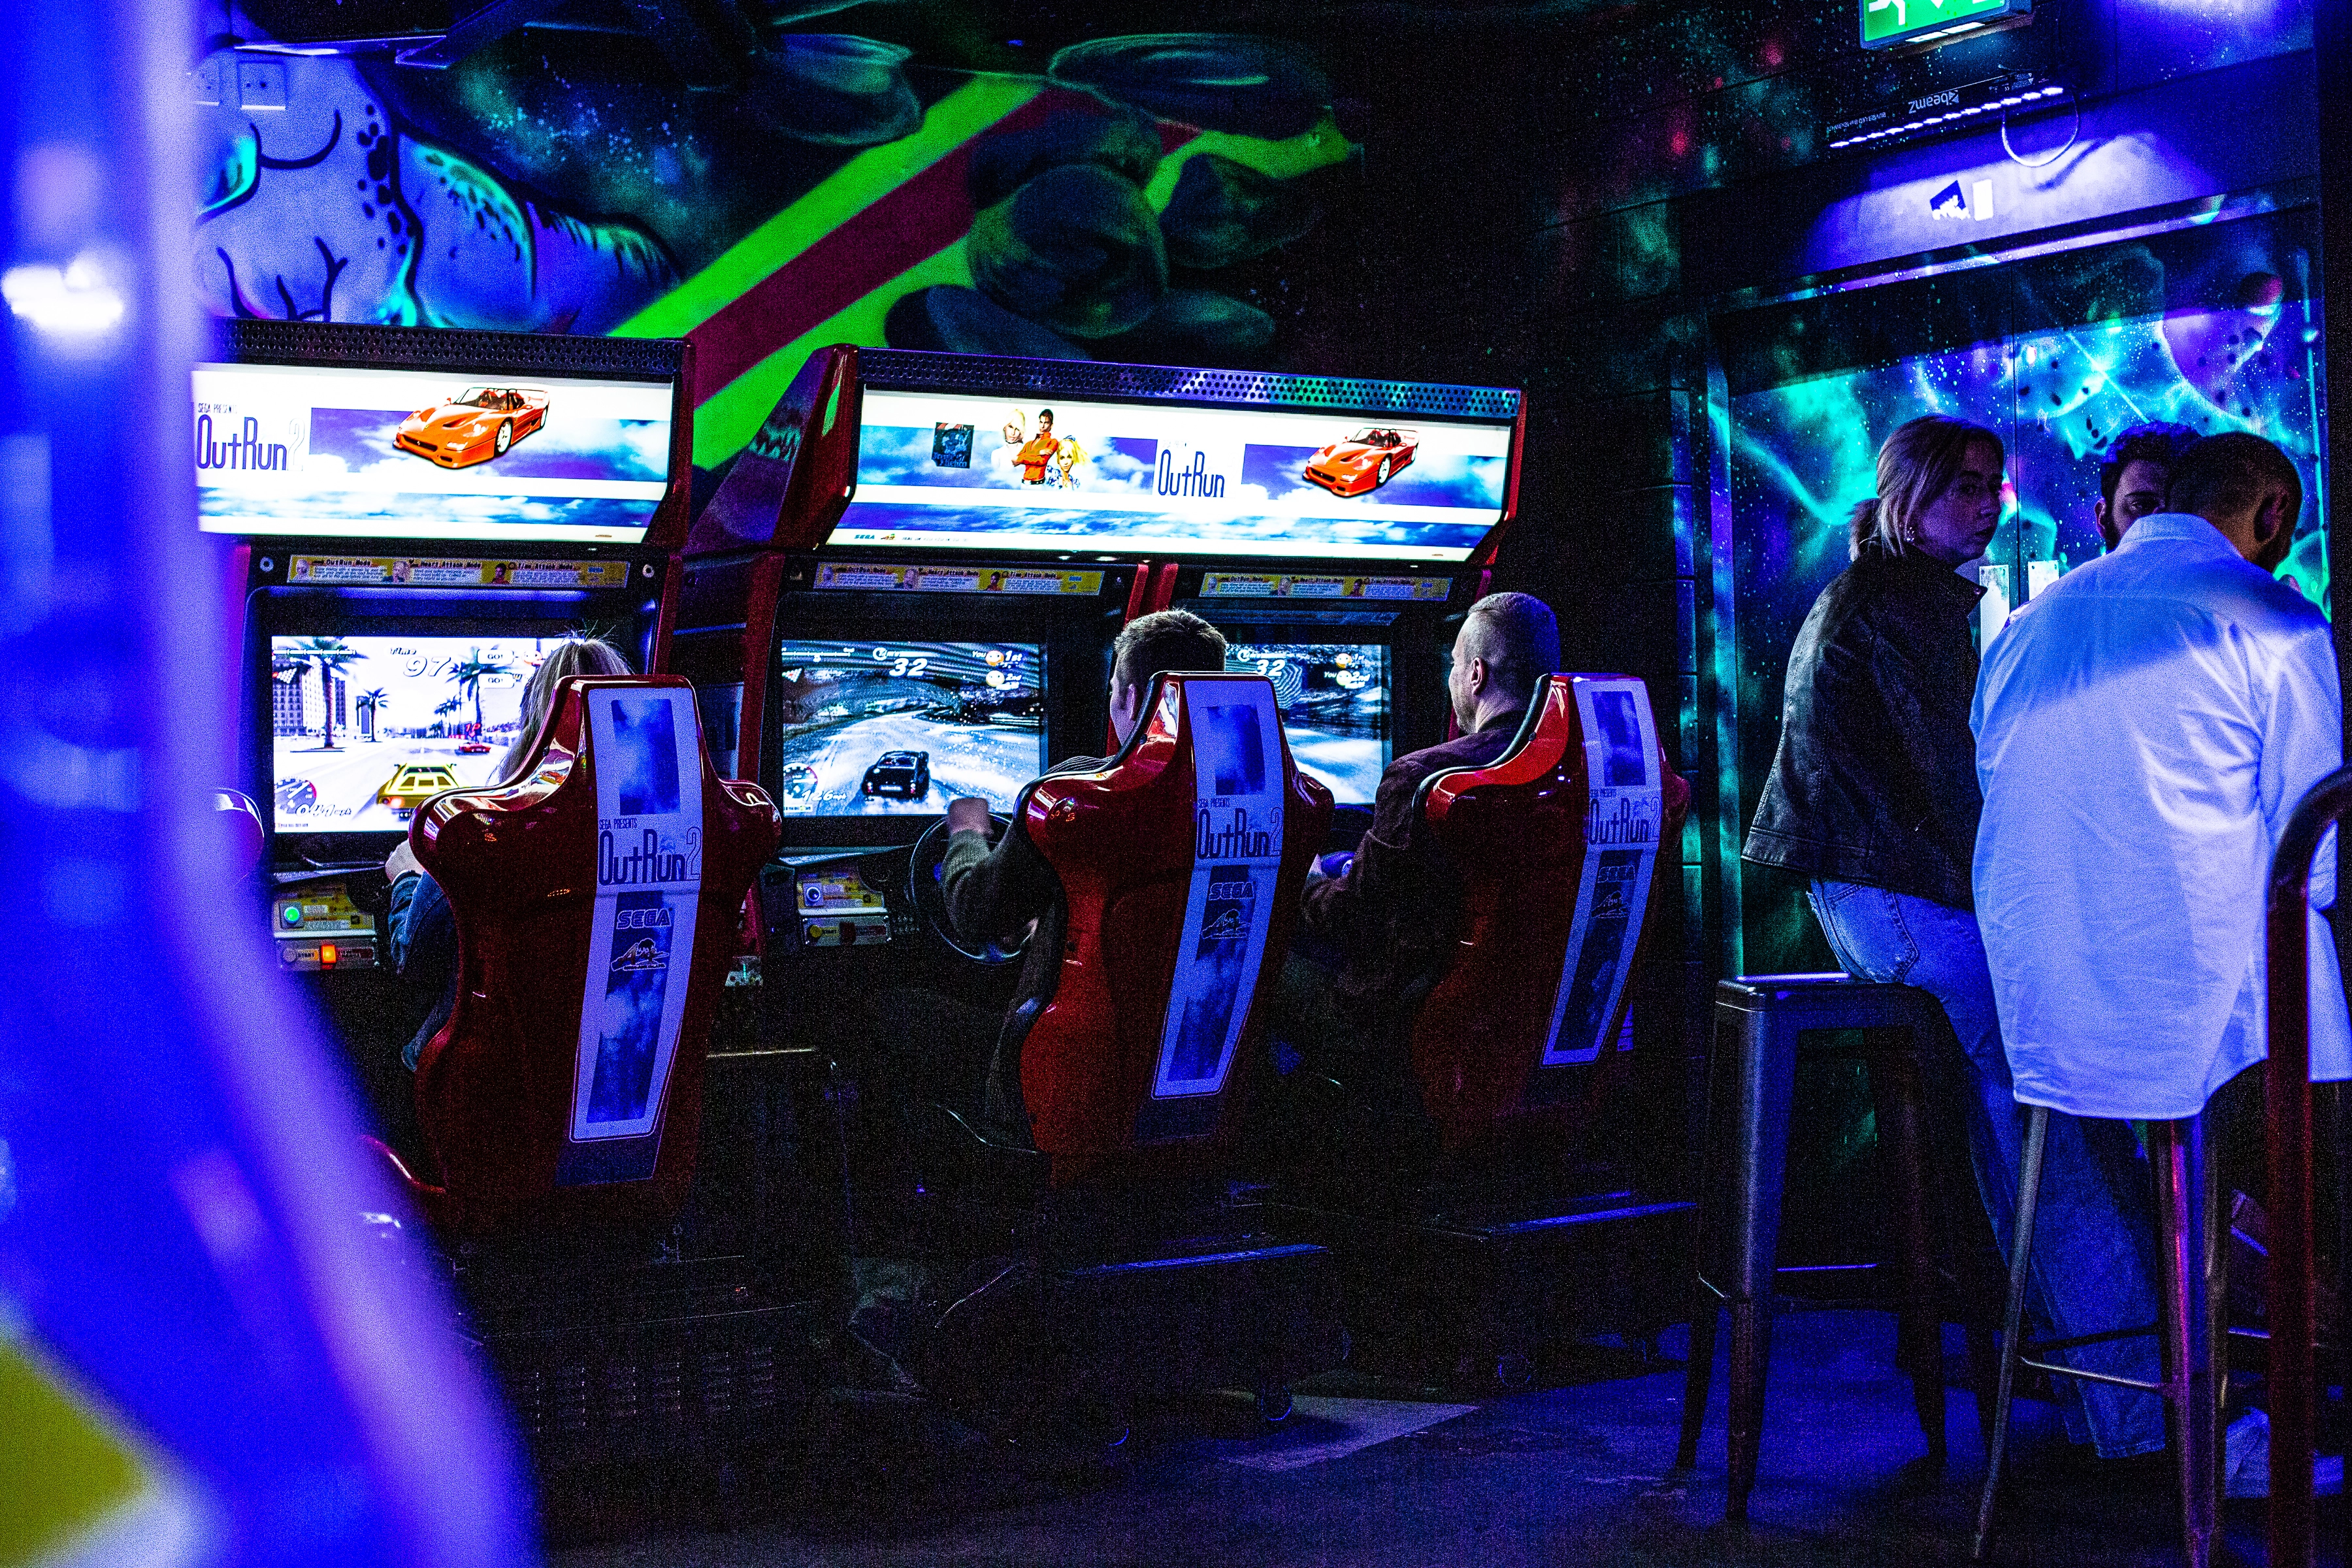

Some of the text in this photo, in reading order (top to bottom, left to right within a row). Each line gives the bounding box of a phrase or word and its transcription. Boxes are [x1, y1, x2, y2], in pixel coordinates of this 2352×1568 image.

[198, 403, 210, 413] SEGA
[1005, 650, 1022, 662] 1st
[403, 656, 451, 678] 97
[889, 657, 928, 678] 32
[1255, 659, 1286, 677] 32
[1005, 673, 1022, 681] 2nd
[1350, 671, 1371, 682] 2nd
[599, 817, 638, 830] SEGA PRESENTS
[1209, 882, 1254, 901] SEGA
[617, 909, 671, 930] SEGA
